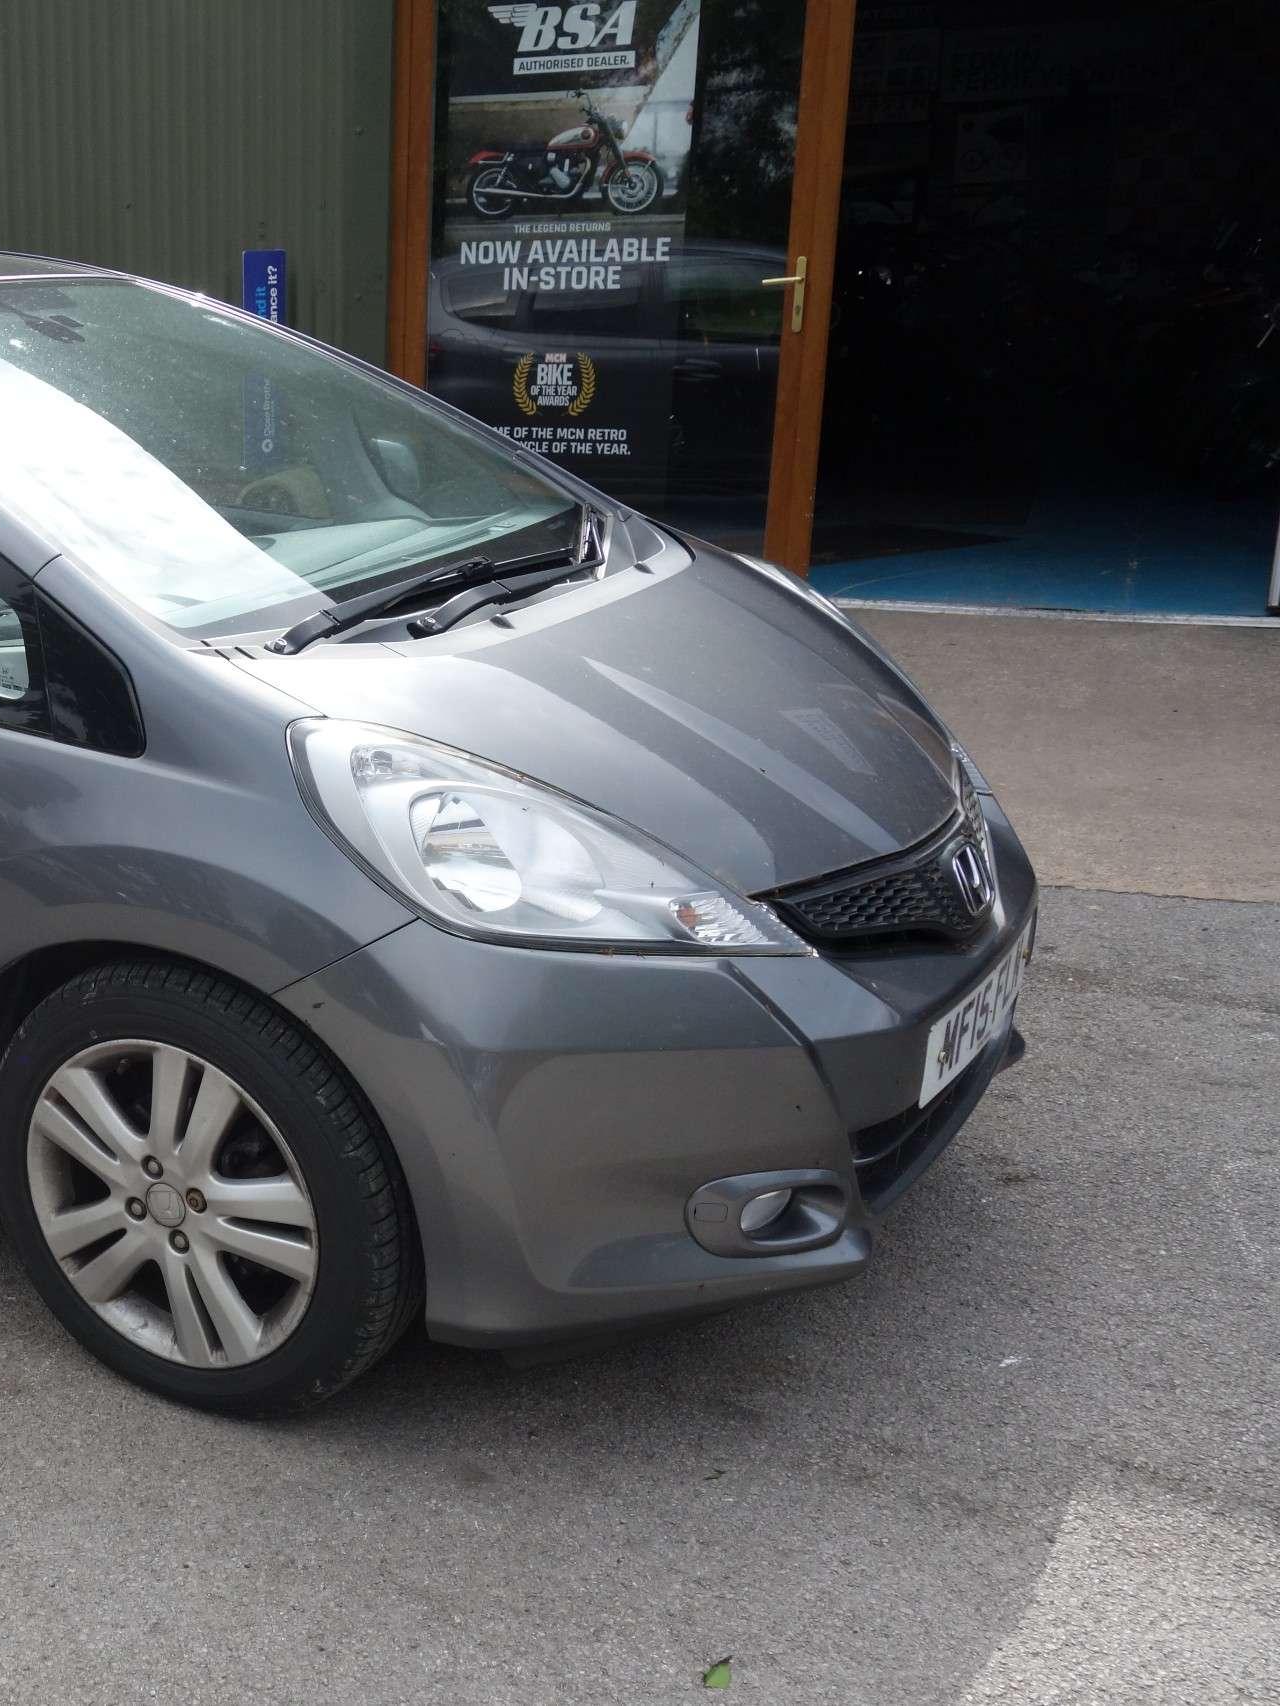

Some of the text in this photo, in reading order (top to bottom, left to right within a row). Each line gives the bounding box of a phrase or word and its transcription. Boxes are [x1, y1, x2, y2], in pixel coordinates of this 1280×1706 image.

[517, 0, 637, 52] BSA
[518, 54, 630, 72] AUTHORISED DEALER.
[514, 222, 611, 233] THE LEGEND RETURNS
[460, 237, 671, 265] NOW AVAILABLE
[267, 265, 278, 285] it?
[504, 265, 622, 291] IN-STORE
[544, 353, 567, 362] MCN
[536, 363, 573, 385] BIKE
[530, 385, 578, 396] OF THE YEAR
[537, 396, 570, 406] AWARDS
[513, 427, 529, 438] OF
[531, 427, 554, 439] THE
[556, 428, 585, 440] MCN
[587, 429, 627, 441] RETRO
[552, 441, 569, 454] OF
[570, 442, 593, 454] THE
[595, 443, 631, 456] YEAR.
